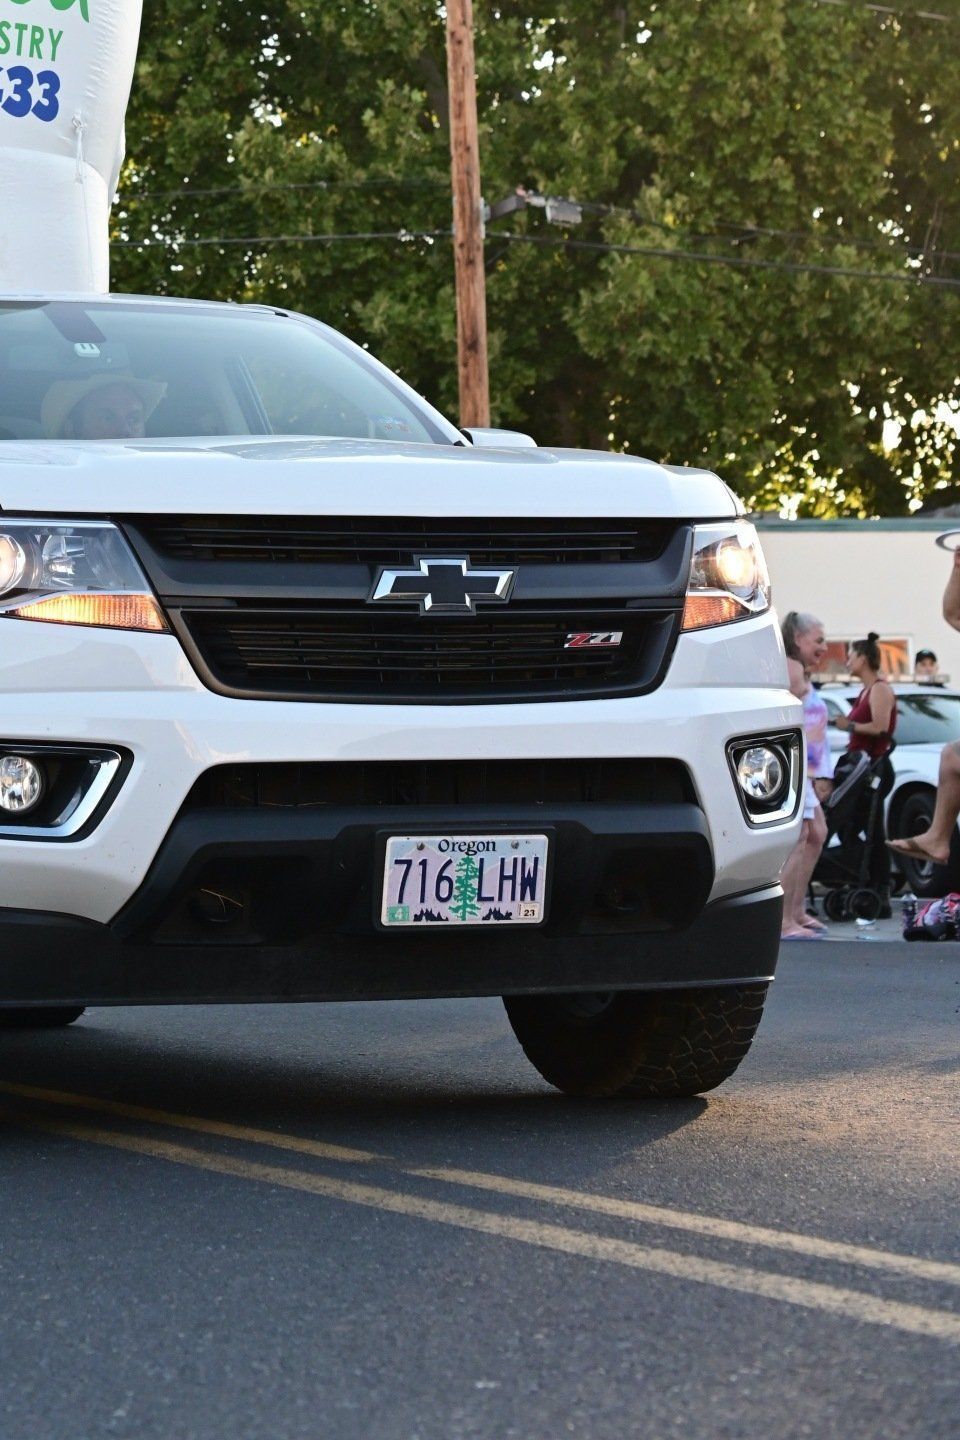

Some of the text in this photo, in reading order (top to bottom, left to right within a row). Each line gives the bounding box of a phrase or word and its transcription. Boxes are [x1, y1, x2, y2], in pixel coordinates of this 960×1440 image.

[563, 632, 623, 648] Z71
[438, 838, 497, 856] Oregon
[394, 856, 539, 904] 716 LHW
